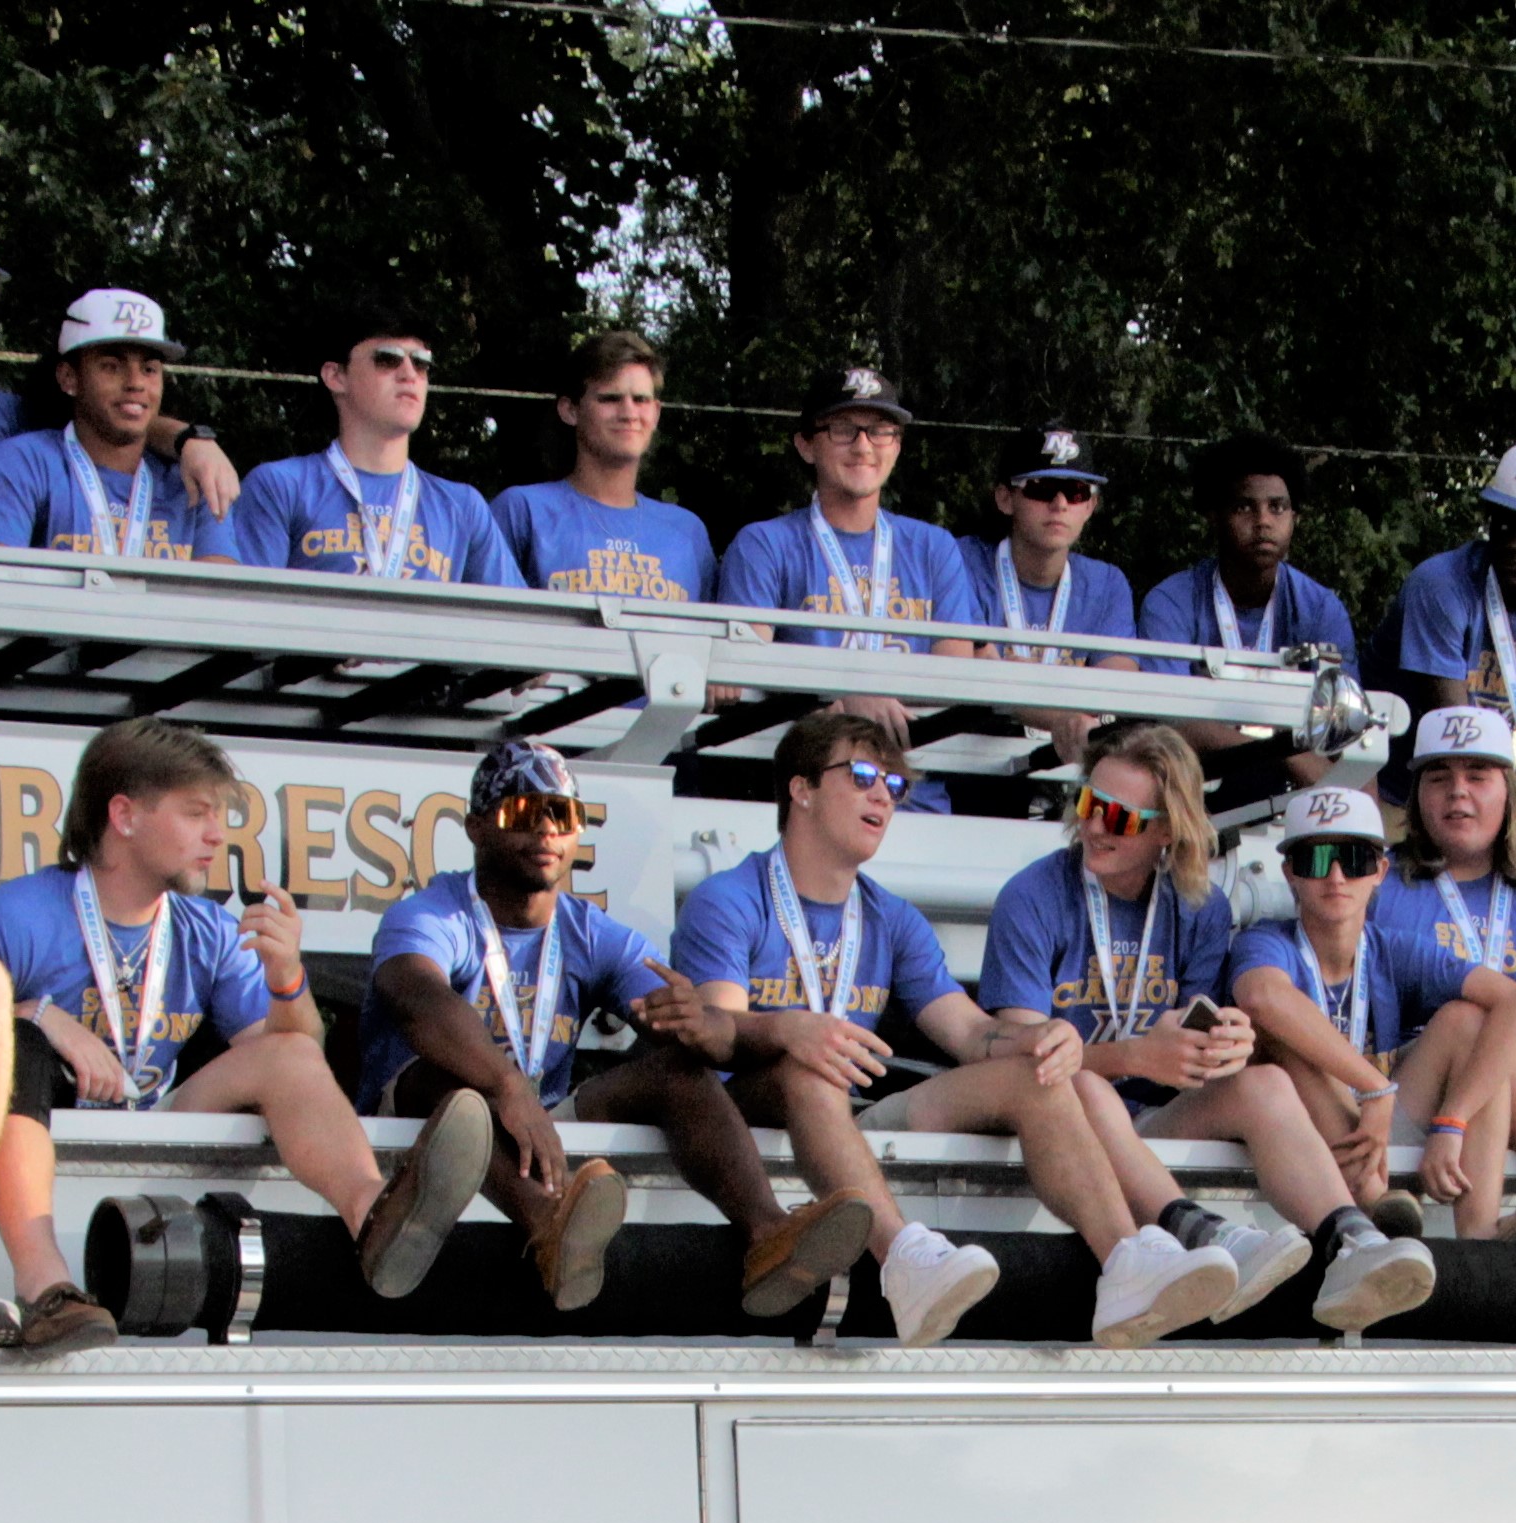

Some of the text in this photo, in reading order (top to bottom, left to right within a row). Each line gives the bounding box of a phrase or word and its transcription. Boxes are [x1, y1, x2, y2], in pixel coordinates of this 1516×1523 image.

[365, 504, 394, 518] 202
[605, 538, 640, 554] 2021
[588, 549, 663, 577] STATE
[1441, 715, 1482, 749] NP
[1307, 792, 1350, 826] NP
[206, 780, 608, 913] RESCE
[774, 864, 800, 930] BASEBALL
[80, 890, 104, 966] BASEBALL
[1112, 940, 1139, 955] 202
[1087, 954, 1165, 979] STAE
